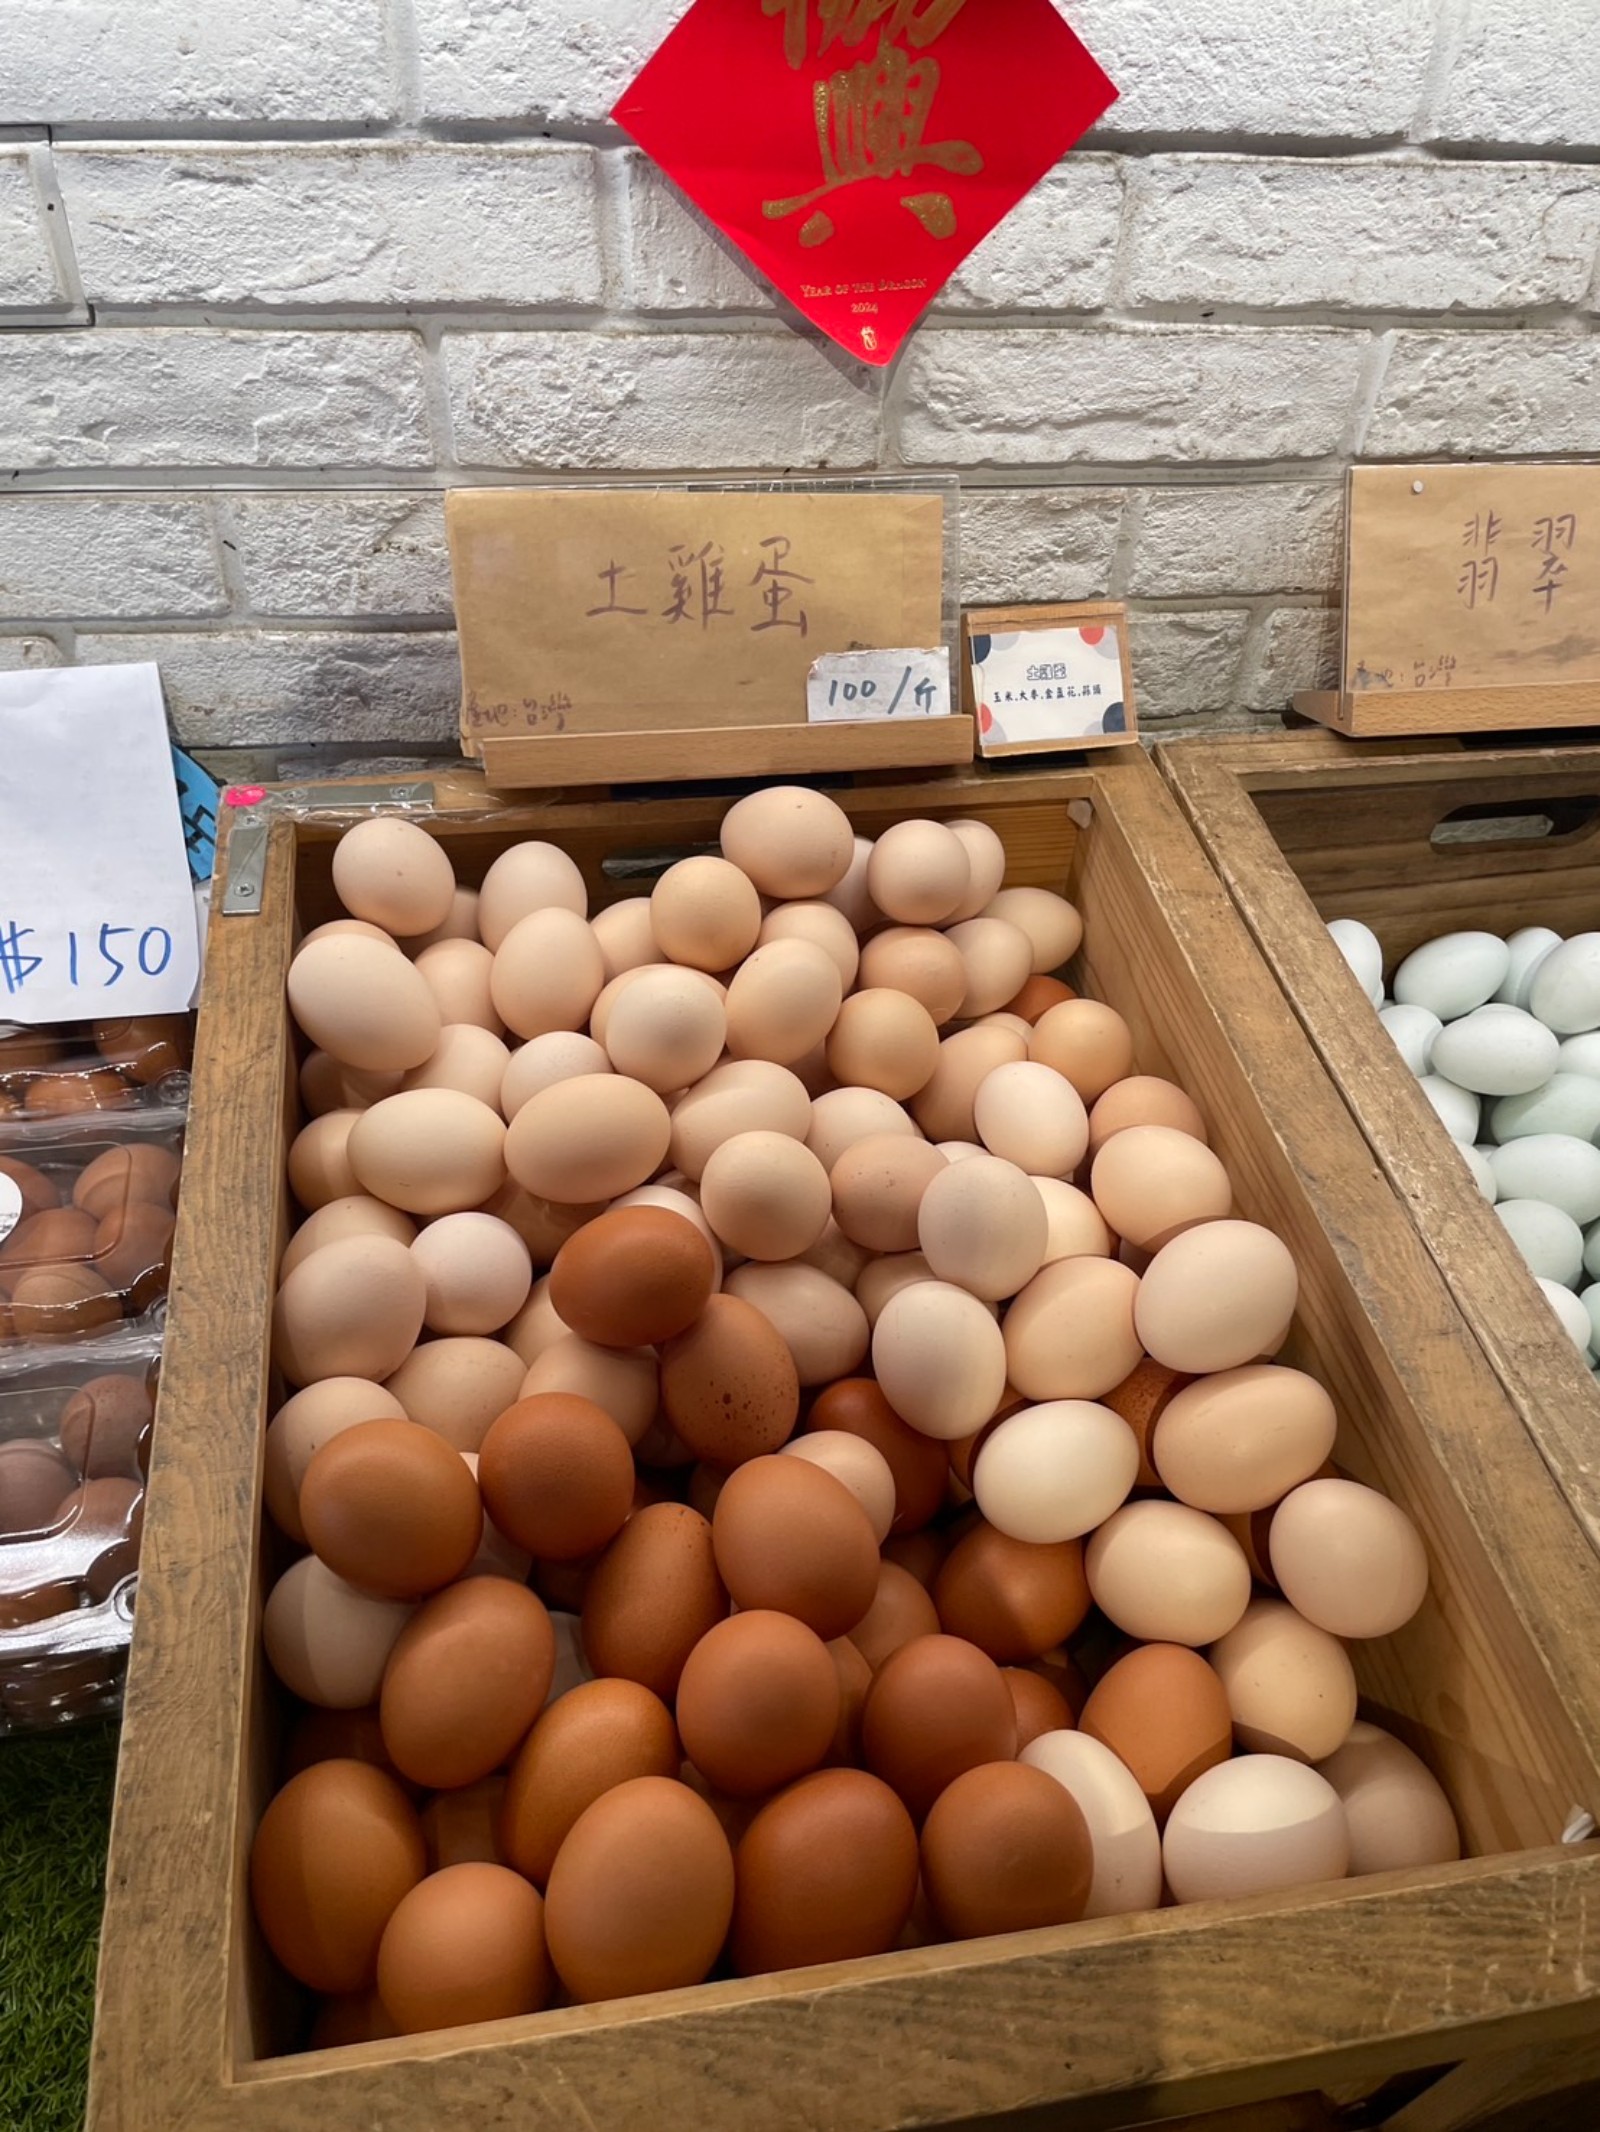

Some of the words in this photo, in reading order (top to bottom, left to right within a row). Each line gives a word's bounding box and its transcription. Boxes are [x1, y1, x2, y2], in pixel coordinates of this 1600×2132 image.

[801, 284, 832, 297] YEAR
[851, 302, 878, 314] 2024
[585, 535, 816, 639] 土雞蛋
